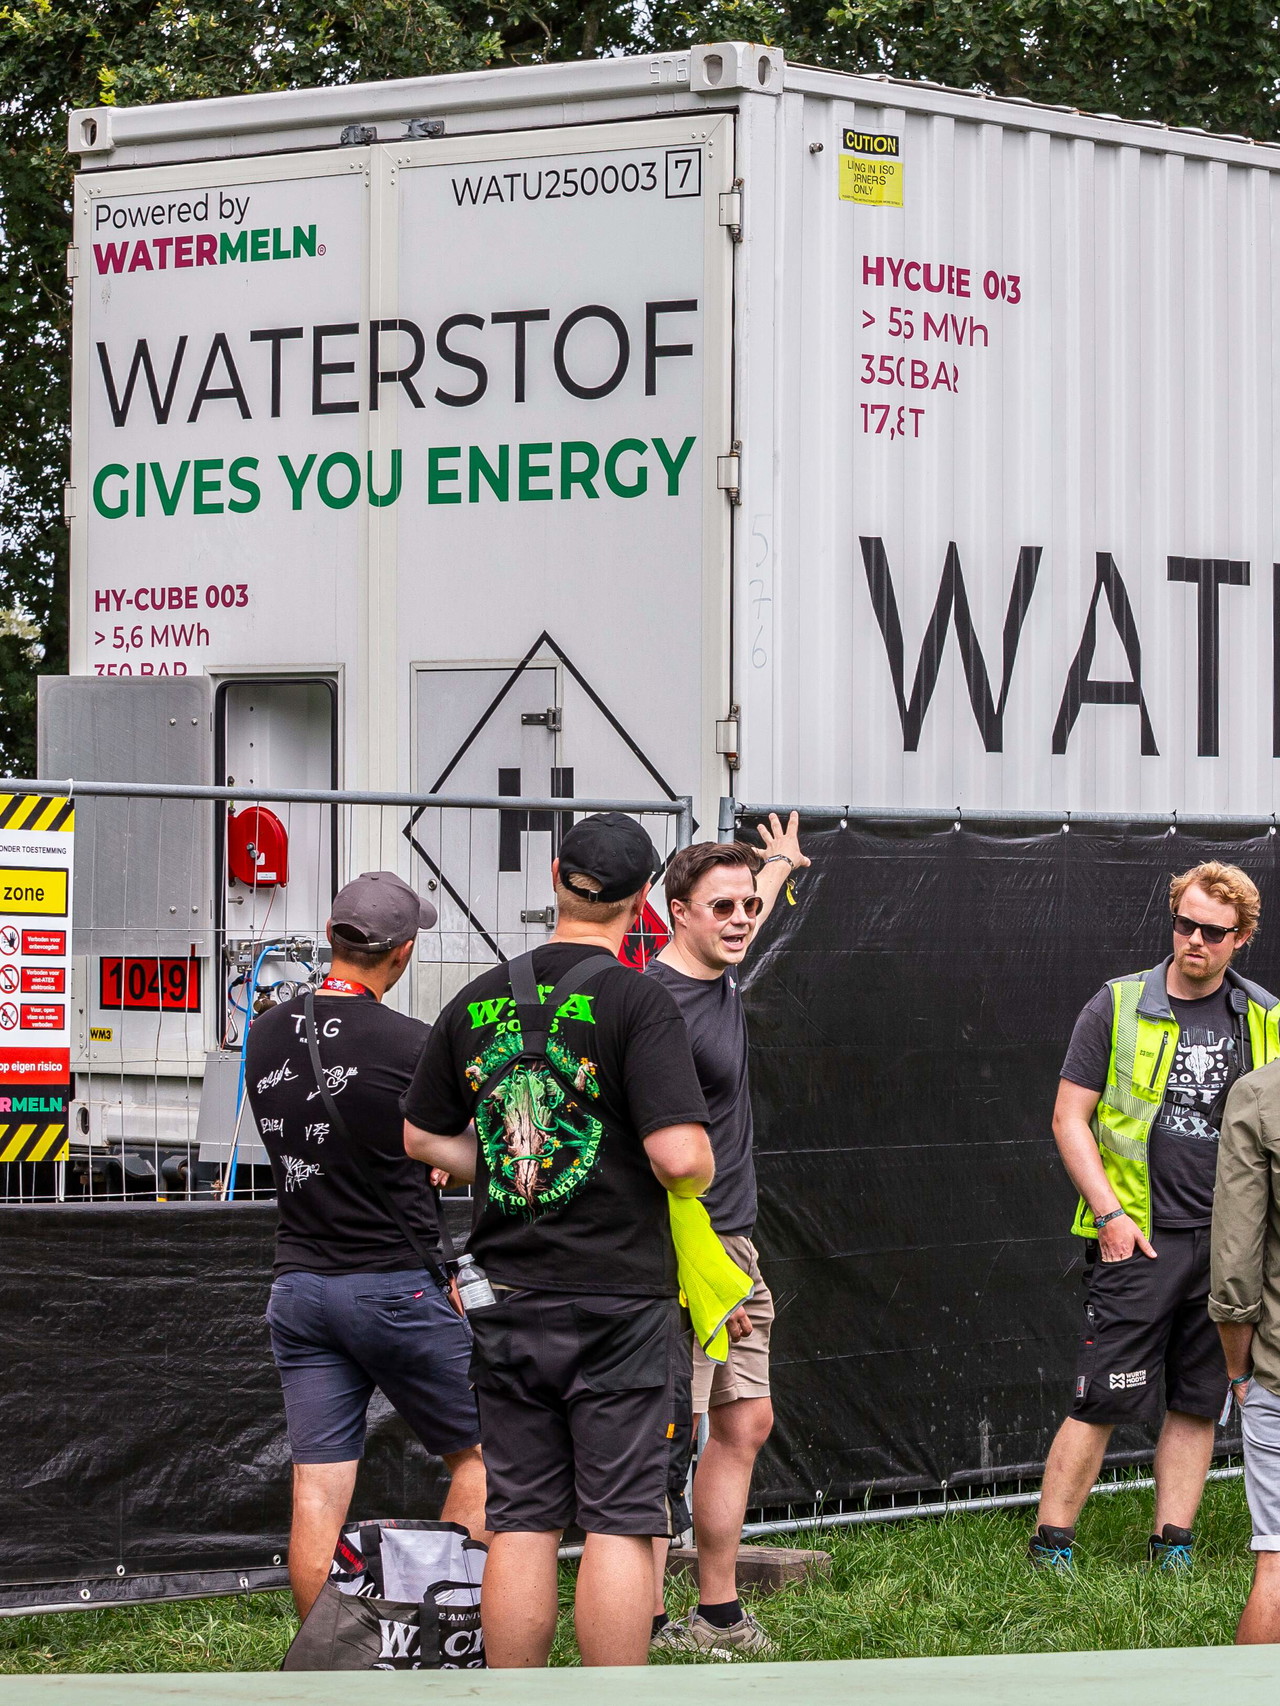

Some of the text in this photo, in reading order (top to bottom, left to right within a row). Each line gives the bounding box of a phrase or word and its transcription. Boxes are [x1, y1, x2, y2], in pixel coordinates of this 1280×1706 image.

[451, 159, 692, 206] WATU250003 7
[880, 165, 895, 175] ISO
[95, 191, 250, 230] Powered by
[96, 299, 698, 428] WATERSTOF
[93, 436, 696, 519] GIVES YOU ENERGY
[95, 584, 249, 612] HY-CUBE 003
[94, 622, 209, 653] > 5,6 MWh
[22, 846, 67, 854] TOESTEMMING
[3, 887, 45, 901] zone
[109, 962, 187, 1002] 1049
[90, 1029, 112, 1040] WM3
[11, 1061, 36, 1074] eigen
[37, 1061, 63, 1071] risico
[509, 1195, 527, 1207] TO
[538, 1176, 578, 1204] MAKE
